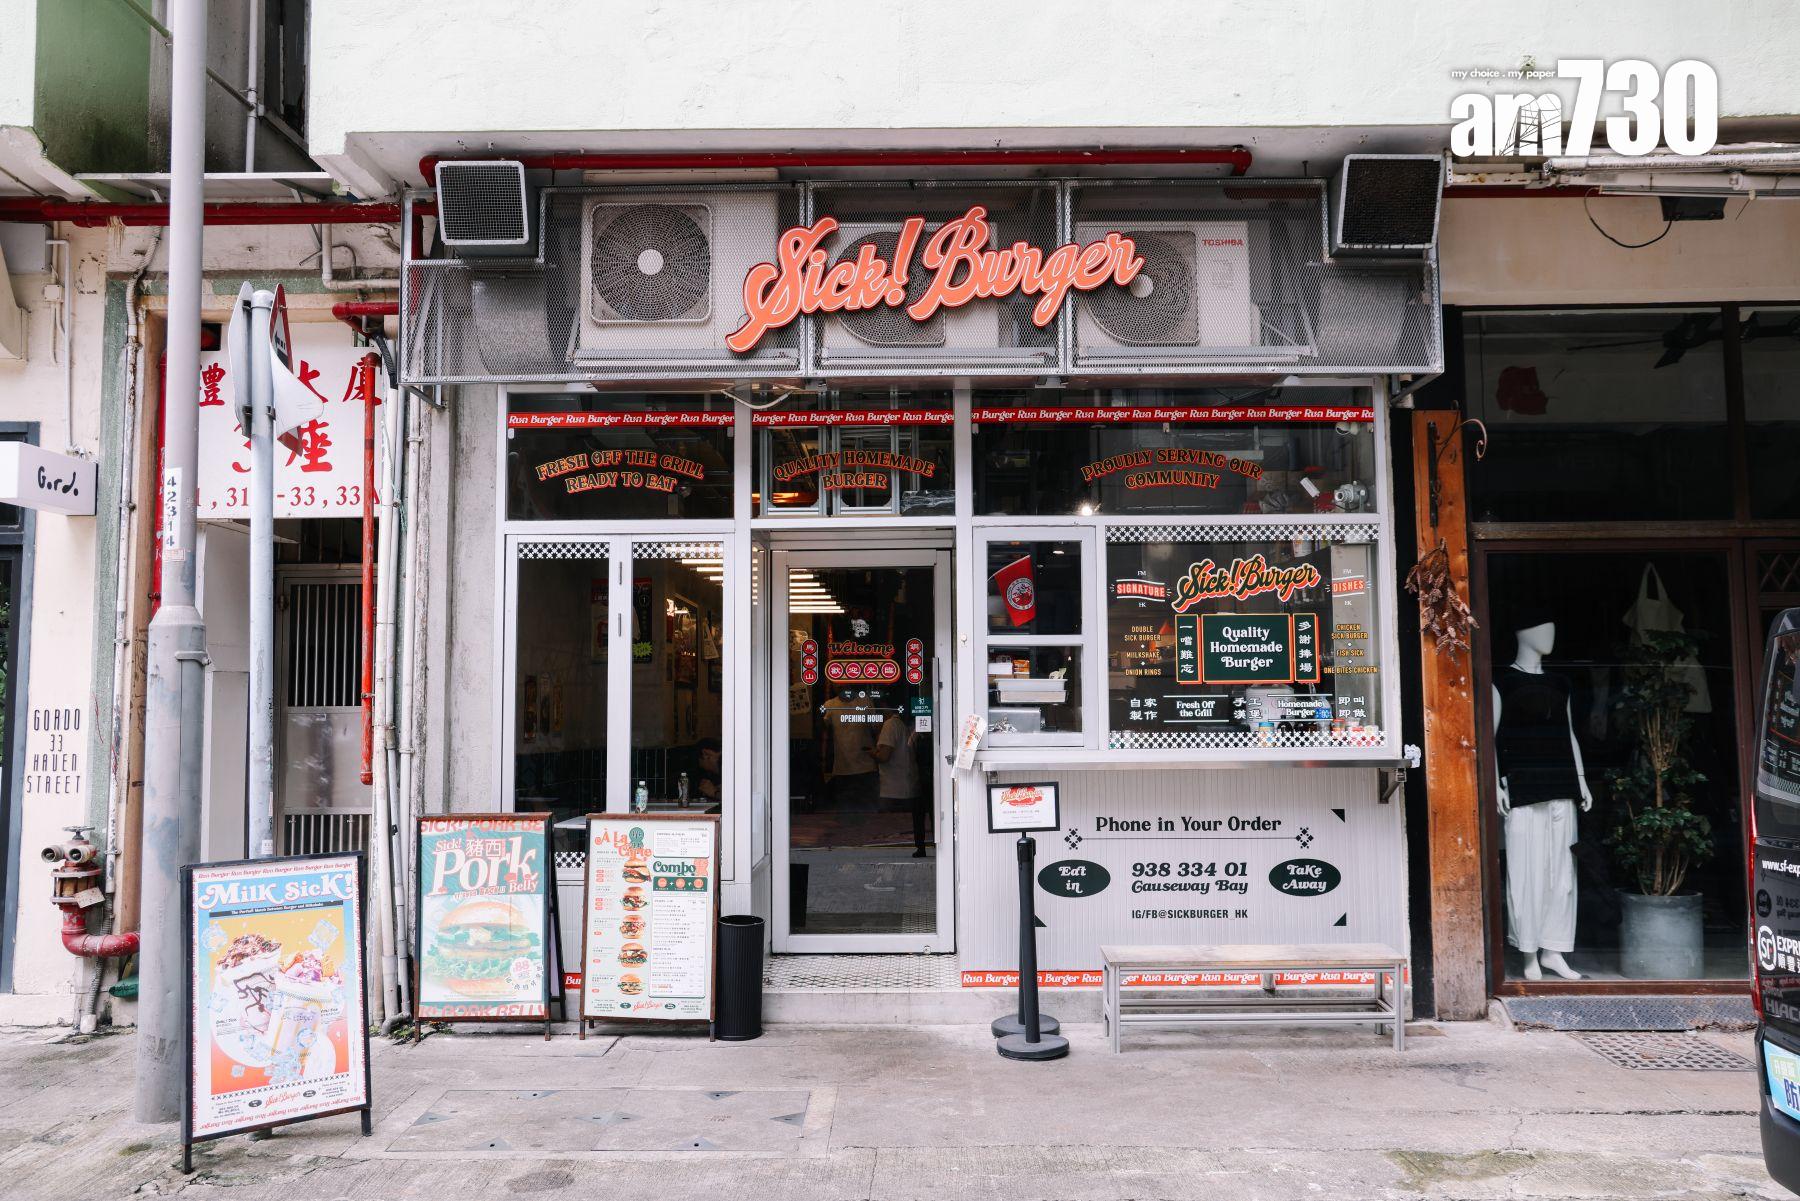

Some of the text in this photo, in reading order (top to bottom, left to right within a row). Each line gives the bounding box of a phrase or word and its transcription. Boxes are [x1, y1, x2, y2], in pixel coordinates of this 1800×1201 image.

[1201, 239, 1244, 247] TOSHIBA
[726, 205, 1145, 353] Sick! Burger
[531, 415, 564, 426] Burger
[588, 415, 621, 425] Burger
[645, 414, 678, 425] Burger
[753, 413, 786, 424] Burger
[810, 413, 843, 424] Burger
[867, 412, 900, 423] Burger
[982, 410, 1015, 421] Burger
[1039, 410, 1073, 421] Burger
[1097, 410, 1130, 420] Burger
[1154, 409, 1187, 420] Burger
[1212, 409, 1245, 419] Burger
[1269, 409, 1302, 419] Burger
[1326, 409, 1360, 420] Burger
[536, 450, 704, 481] FRESH OFF THE GRILL
[774, 451, 936, 481] QUALITY HOMEMADE
[1081, 449, 1264, 481] PROUDLY SERVING OUR
[565, 472, 678, 493] READY TO EAT
[821, 472, 888, 490] BURGER
[1125, 470, 1220, 489] COMMUNITY
[1116, 583, 1166, 598] SIGNATURE
[1171, 553, 1322, 613] Sick! Burger
[1333, 580, 1364, 592] DISHES
[1222, 627, 1271, 643] Quality
[1336, 624, 1361, 632] CHICKEN
[1331, 632, 1369, 640] SICK BURGER
[828, 641, 895, 657] Welcome
[1210, 641, 1283, 654] Homemade
[1221, 656, 1274, 671] Burger
[1323, 666, 1336, 674] ONE
[1130, 698, 1158, 708] 自家
[1176, 700, 1216, 709] Fresh Off
[1232, 697, 1262, 707] 手工
[1277, 700, 1323, 708] Homemade
[33, 708, 82, 731] GORDO
[840, 714, 884, 723] OPENING HOUR
[1179, 709, 1212, 717] the Grill
[1286, 708, 1316, 718] Burger
[50, 734, 63, 753] 33
[26, 774, 82, 794] STREET
[1095, 816, 1282, 832] Phone in Your Order
[428, 836, 539, 896] Pork
[653, 860, 697, 877] Combo
[1058, 865, 1088, 877] Eat
[1131, 862, 1249, 878] 938 334 01
[508, 880, 538, 894] Belly
[1064, 878, 1084, 894] in
[1131, 879, 1249, 895] Causeway Bay
[1281, 878, 1328, 893] Away
[1131, 908, 1249, 920] IG/FB@SICKBURGER_HK
[1045, 974, 1079, 985] Burger
